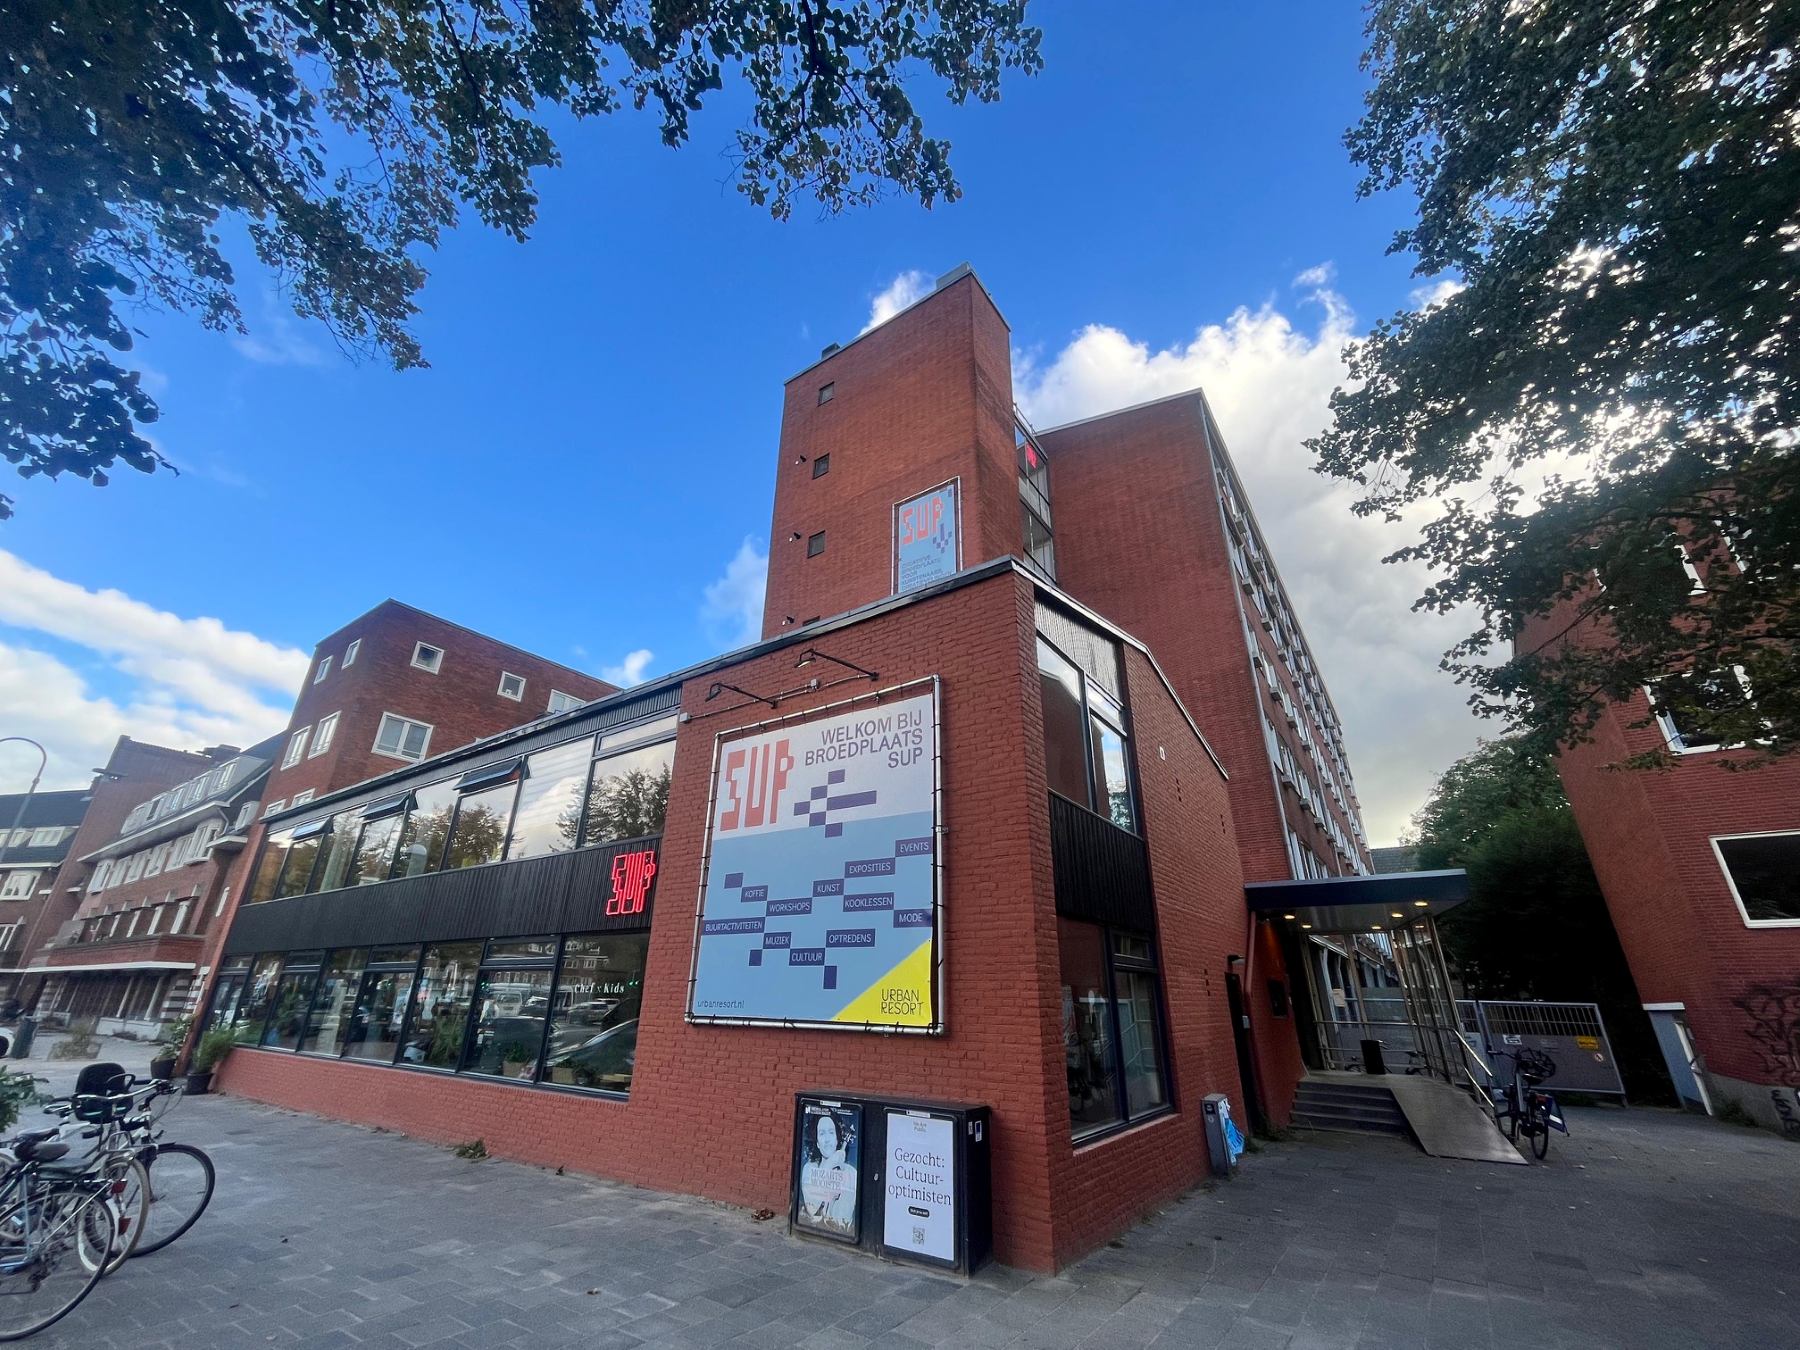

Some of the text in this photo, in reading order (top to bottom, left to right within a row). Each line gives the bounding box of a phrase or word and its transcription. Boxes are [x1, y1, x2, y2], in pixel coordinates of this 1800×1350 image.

[902, 496, 944, 545] SUP
[821, 709, 923, 746] WELKOM BIJ
[804, 728, 924, 767] BROEDPLAATS
[887, 746, 924, 769] SUP
[720, 738, 795, 832] SUP
[900, 841, 930, 853] EVENTS
[849, 861, 892, 874] EXPOSITIES
[605, 850, 656, 916] SUP
[817, 883, 841, 894] KUNST
[744, 888, 765, 899] KOFFIE
[768, 901, 811, 913] WORKSHOPS
[844, 896, 893, 909] KOOKLESSEN
[898, 912, 924, 923] MODE
[705, 920, 763, 932] BUURTACTIVITEITEN
[765, 935, 790, 946] MUZIEK
[828, 933, 873, 944] OPTREDENS
[791, 951, 824, 963] CULTUUR
[603, 982, 625, 994] Kids
[881, 988, 920, 1002] URBAN
[696, 999, 746, 1009] urbanresort.nl
[880, 1001, 925, 1016] RESORT
[894, 1147, 945, 1169] Gezocht:
[895, 1165, 945, 1185] Cultuur-
[888, 1184, 952, 1206] optimisten
